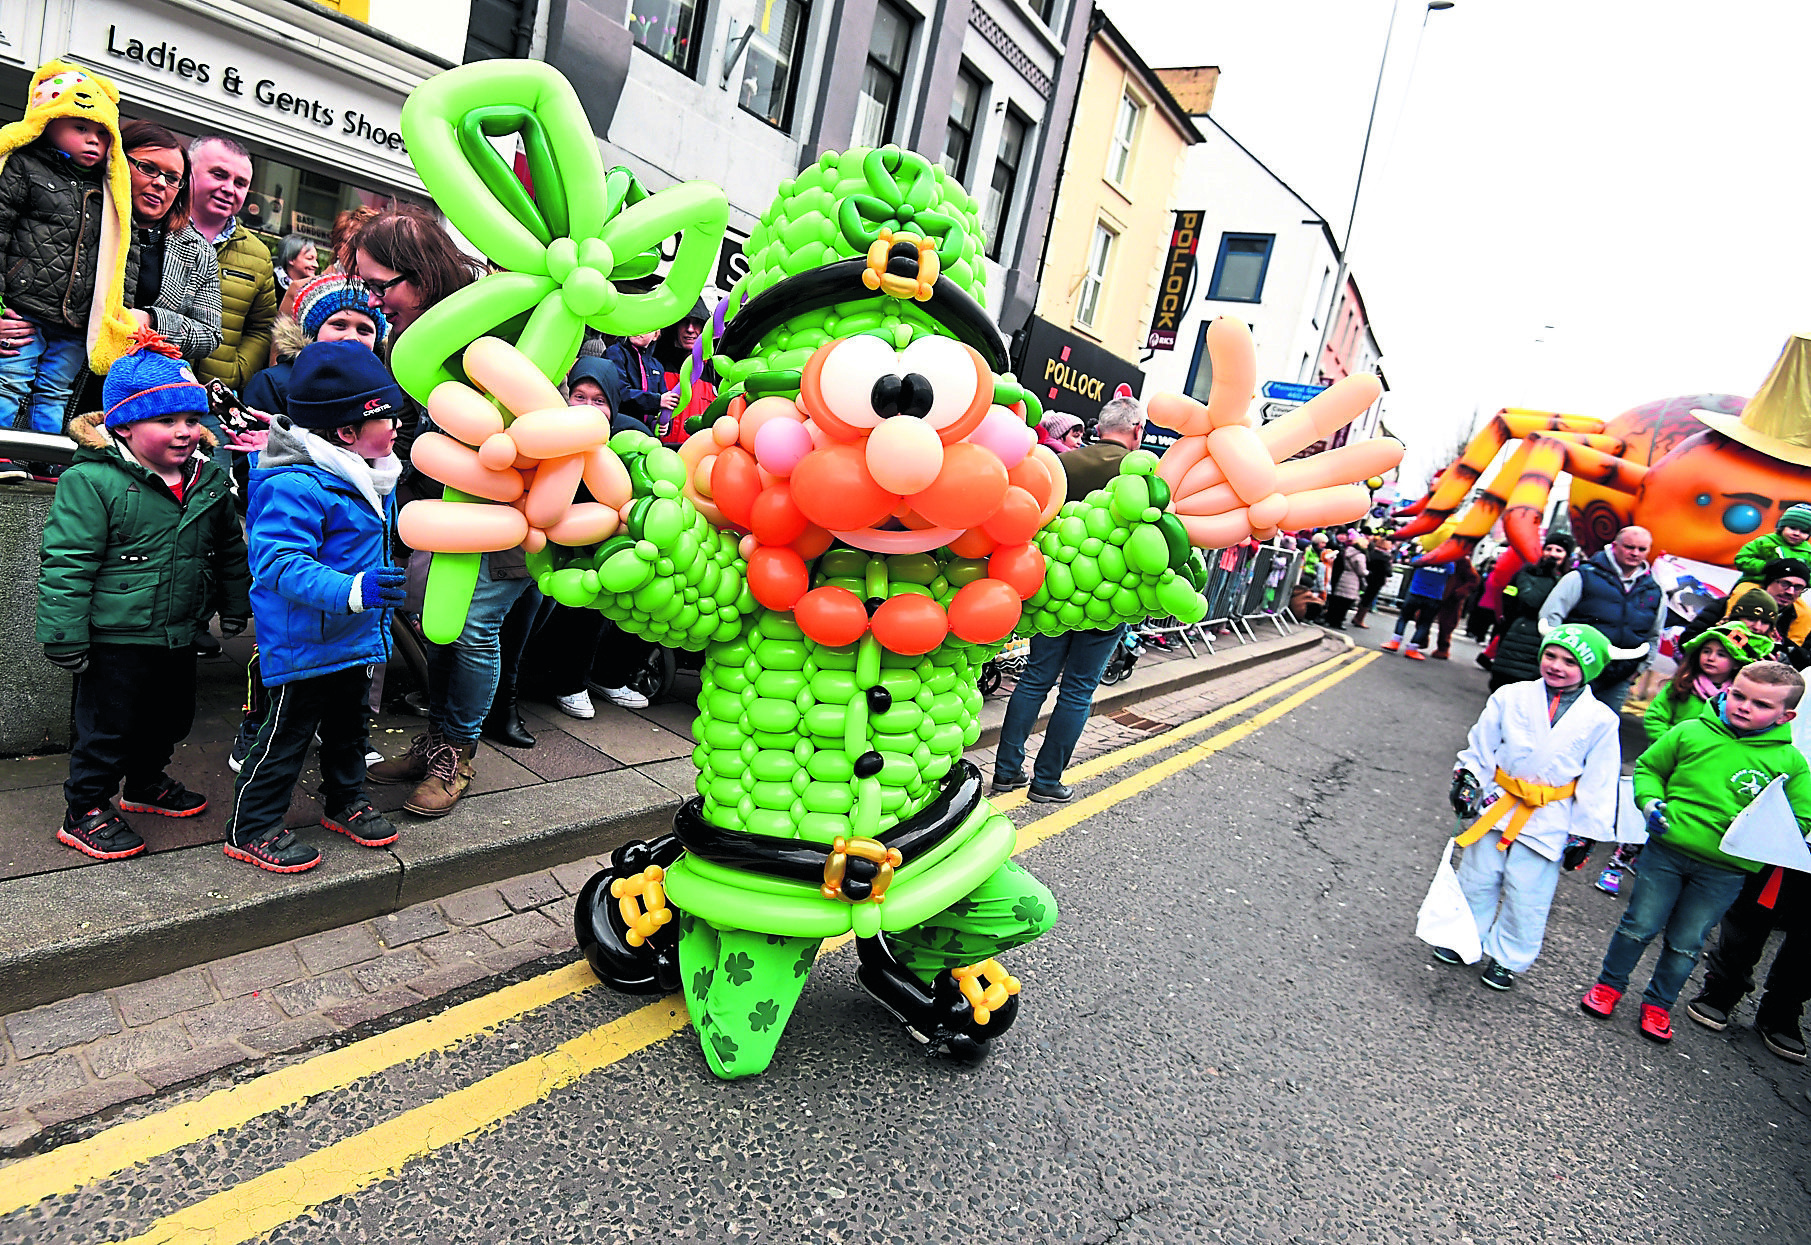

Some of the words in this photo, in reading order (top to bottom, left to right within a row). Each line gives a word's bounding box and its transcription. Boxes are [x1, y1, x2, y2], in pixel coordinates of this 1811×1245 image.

[106, 24, 211, 84] Ladies
[222, 66, 244, 97] &
[255, 79, 334, 127] Gents
[1157, 212, 1198, 328] POLLOCK
[1044, 358, 1105, 402] POLLOCK
